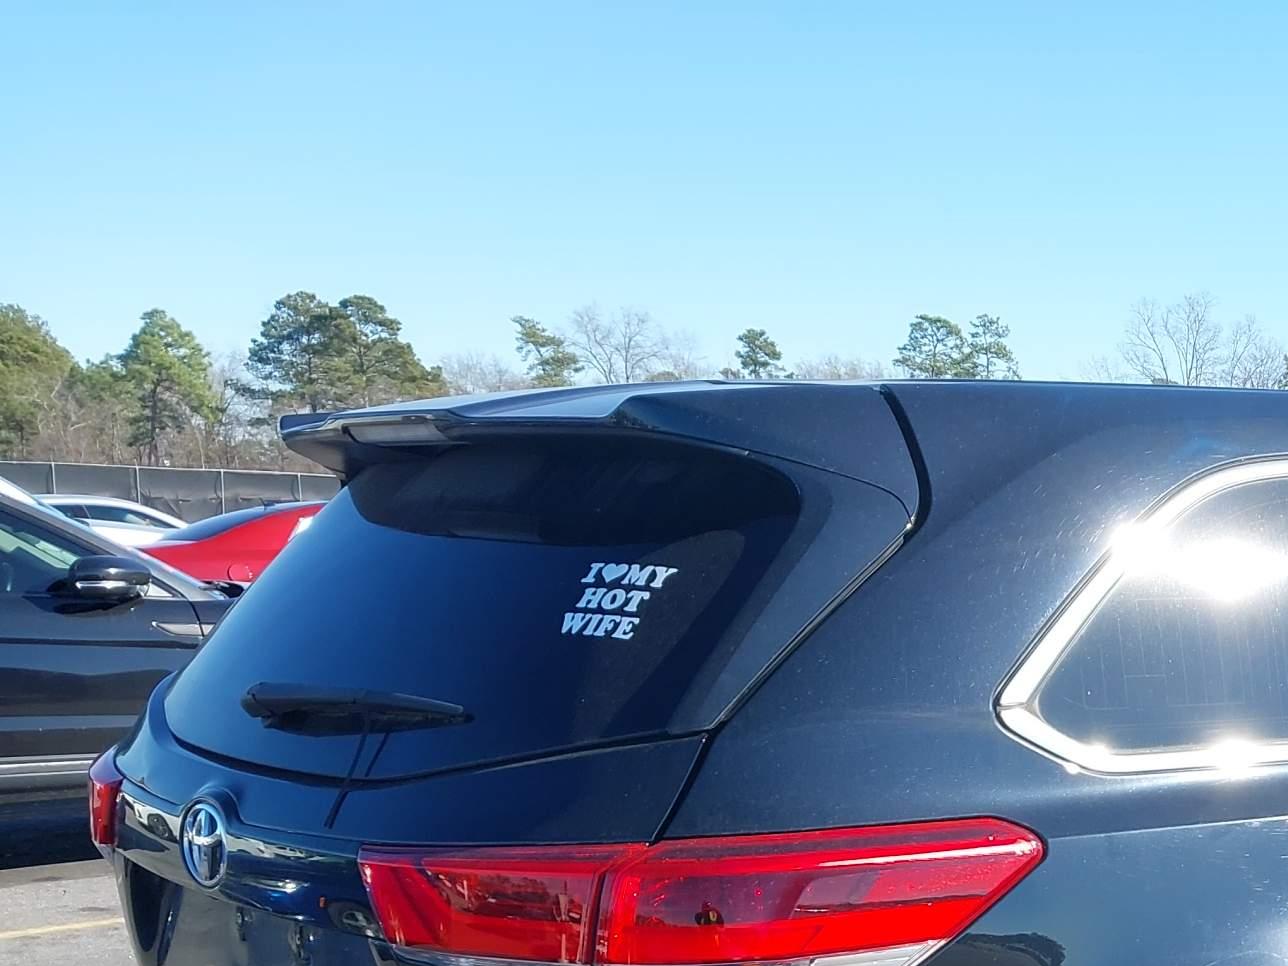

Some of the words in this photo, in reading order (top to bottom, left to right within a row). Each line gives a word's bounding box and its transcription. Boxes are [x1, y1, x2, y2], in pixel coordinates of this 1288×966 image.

[620, 563, 678, 588] MY
[575, 587, 650, 612] HOT
[561, 612, 640, 640] WIFE
